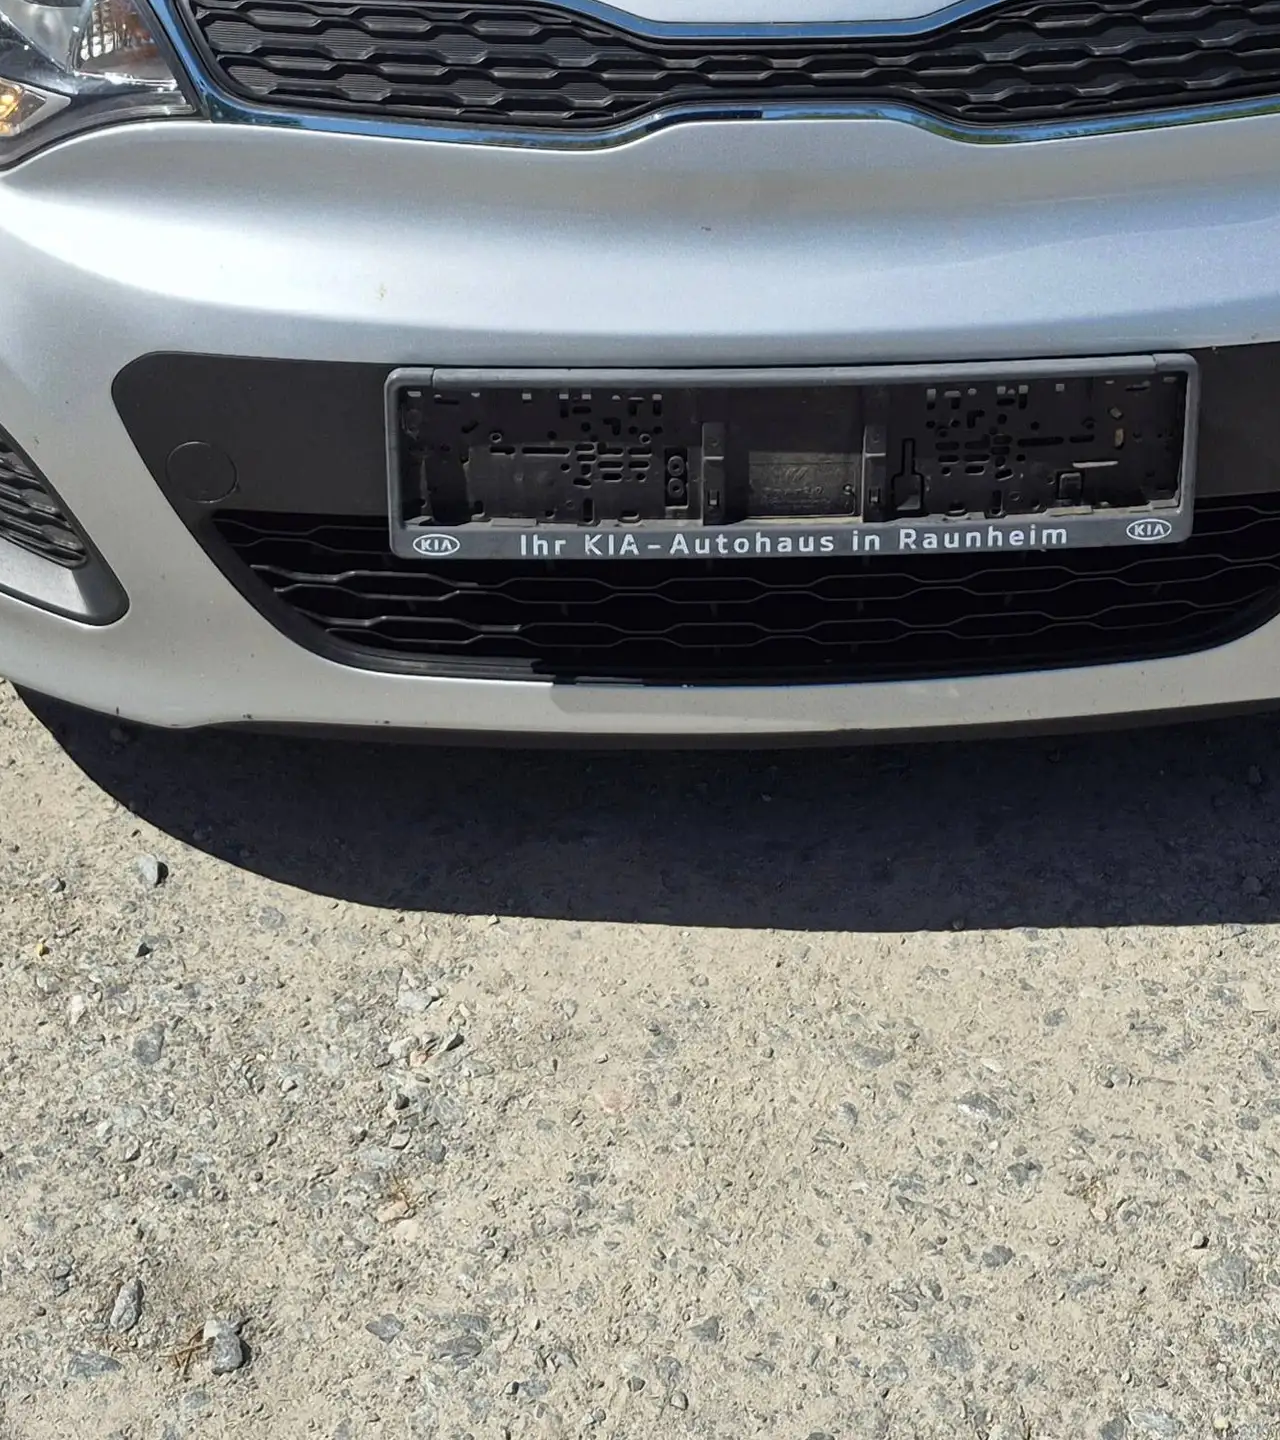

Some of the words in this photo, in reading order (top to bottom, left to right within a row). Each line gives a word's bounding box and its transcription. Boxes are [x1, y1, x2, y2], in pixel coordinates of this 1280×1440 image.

[1134, 523, 1165, 536] KIA
[420, 539, 453, 552] KIA
[520, 534, 566, 556] Ihr
[852, 529, 880, 551] in
[899, 525, 1068, 550] Raunheim
